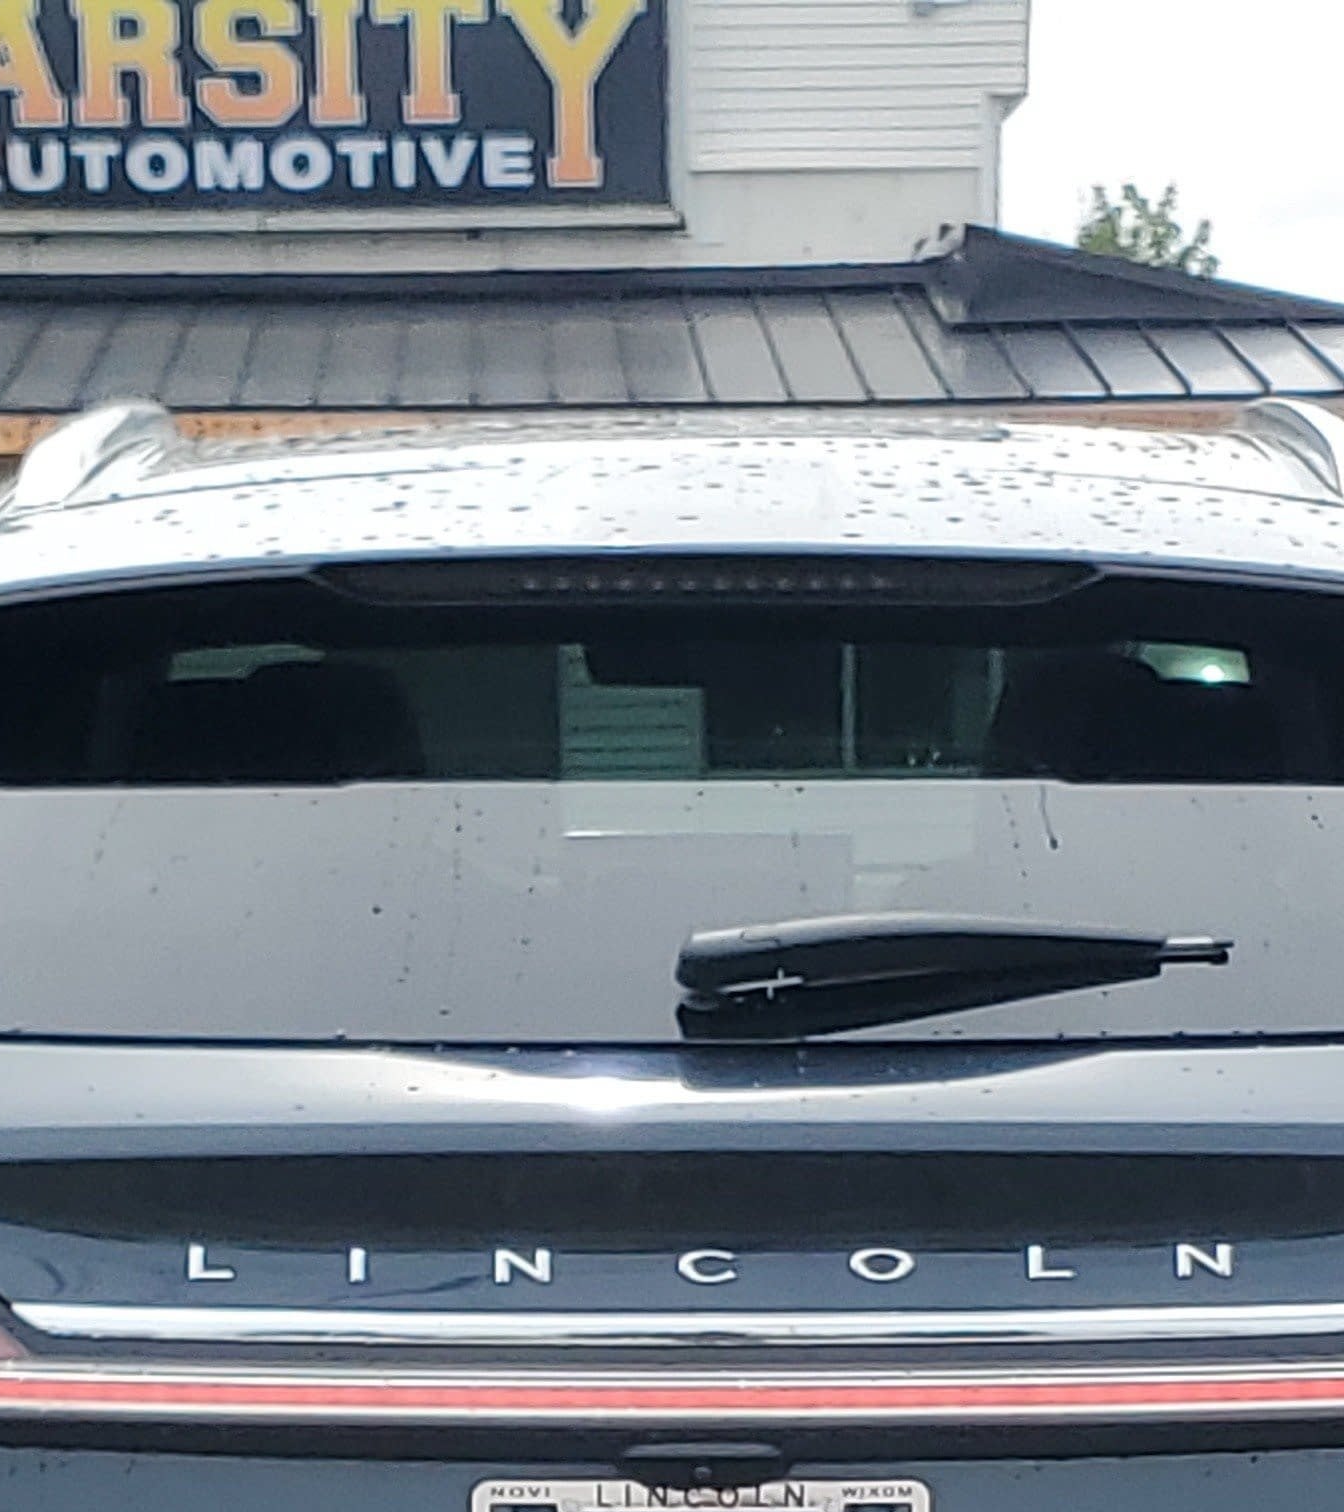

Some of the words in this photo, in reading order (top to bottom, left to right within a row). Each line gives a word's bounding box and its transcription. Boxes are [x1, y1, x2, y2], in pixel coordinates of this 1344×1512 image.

[187, 1242, 1234, 1286] LINCOLN
[490, 1486, 551, 1498] NOVI
[841, 1486, 914, 1499] WIXOM
